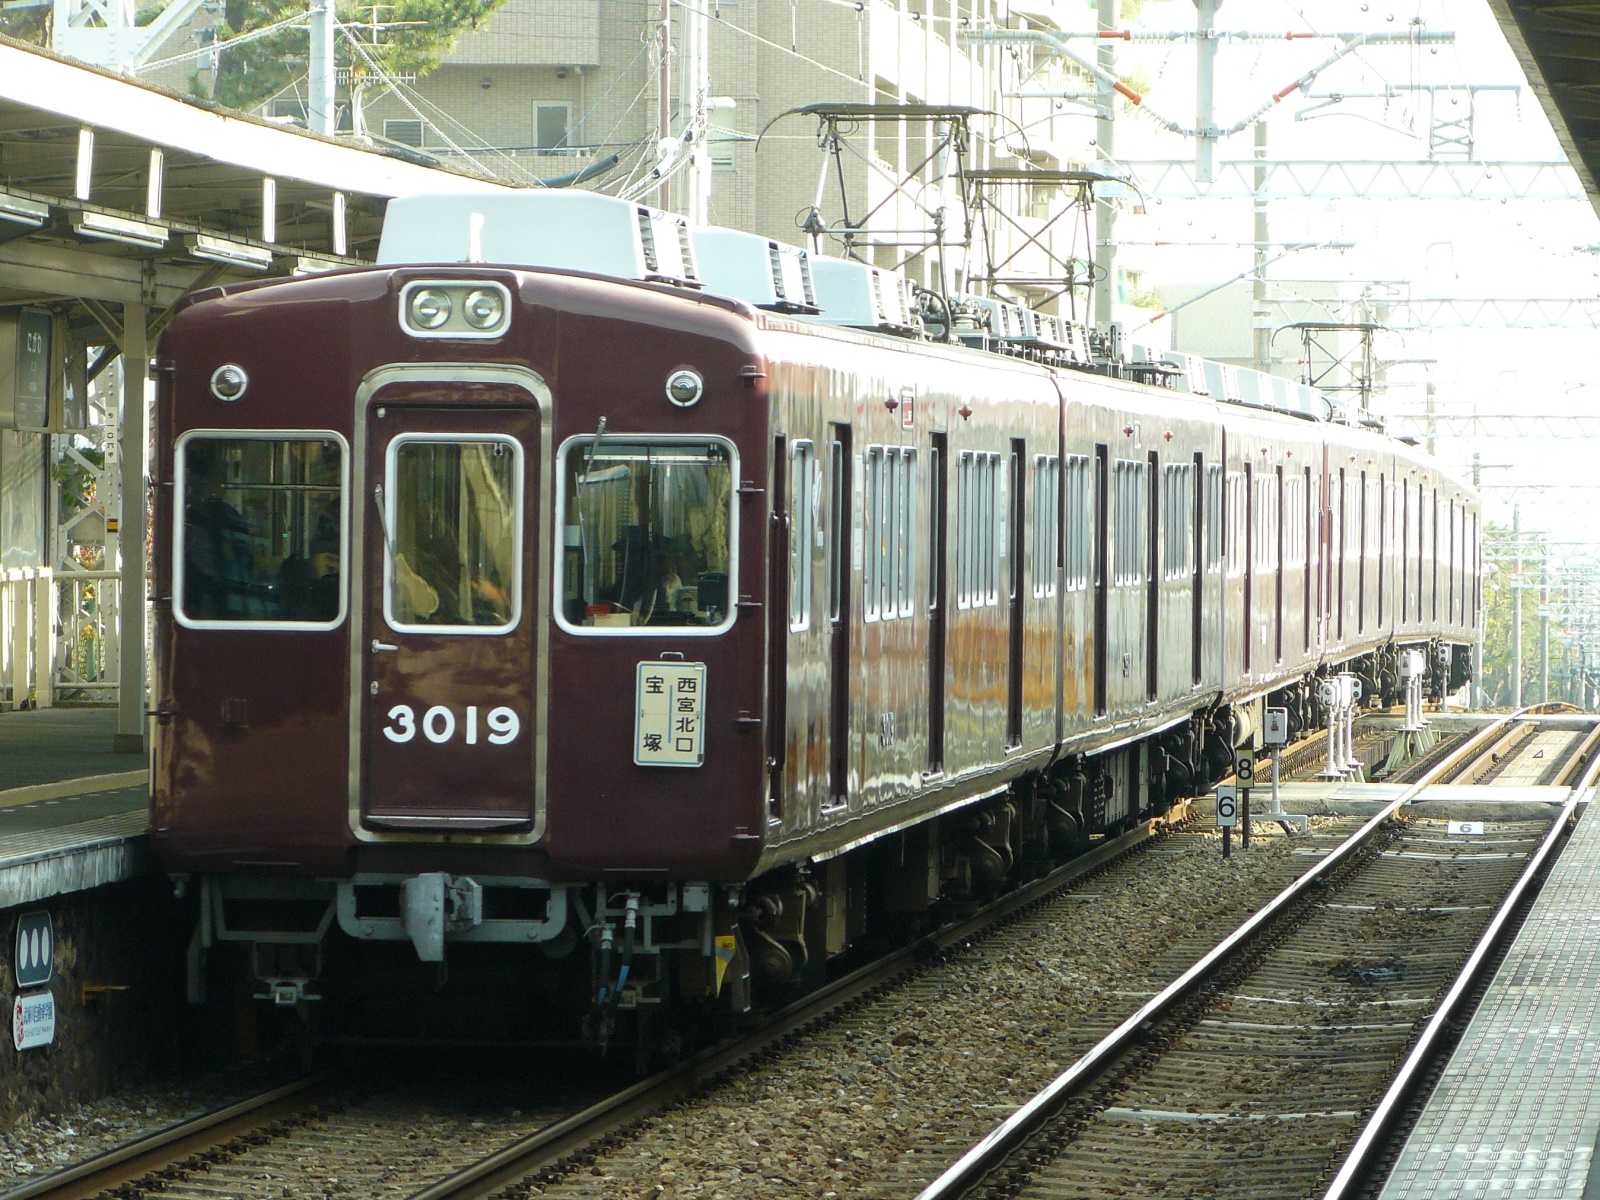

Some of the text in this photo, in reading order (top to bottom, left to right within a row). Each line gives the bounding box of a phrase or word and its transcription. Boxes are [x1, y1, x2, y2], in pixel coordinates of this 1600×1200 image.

[382, 704, 520, 745] 3019
[643, 675, 664, 752] 宝塚
[675, 677, 697, 752] 西宮北口
[1237, 758, 1252, 780] 8
[1218, 796, 1235, 818] 6
[1459, 823, 1472, 833] 6
